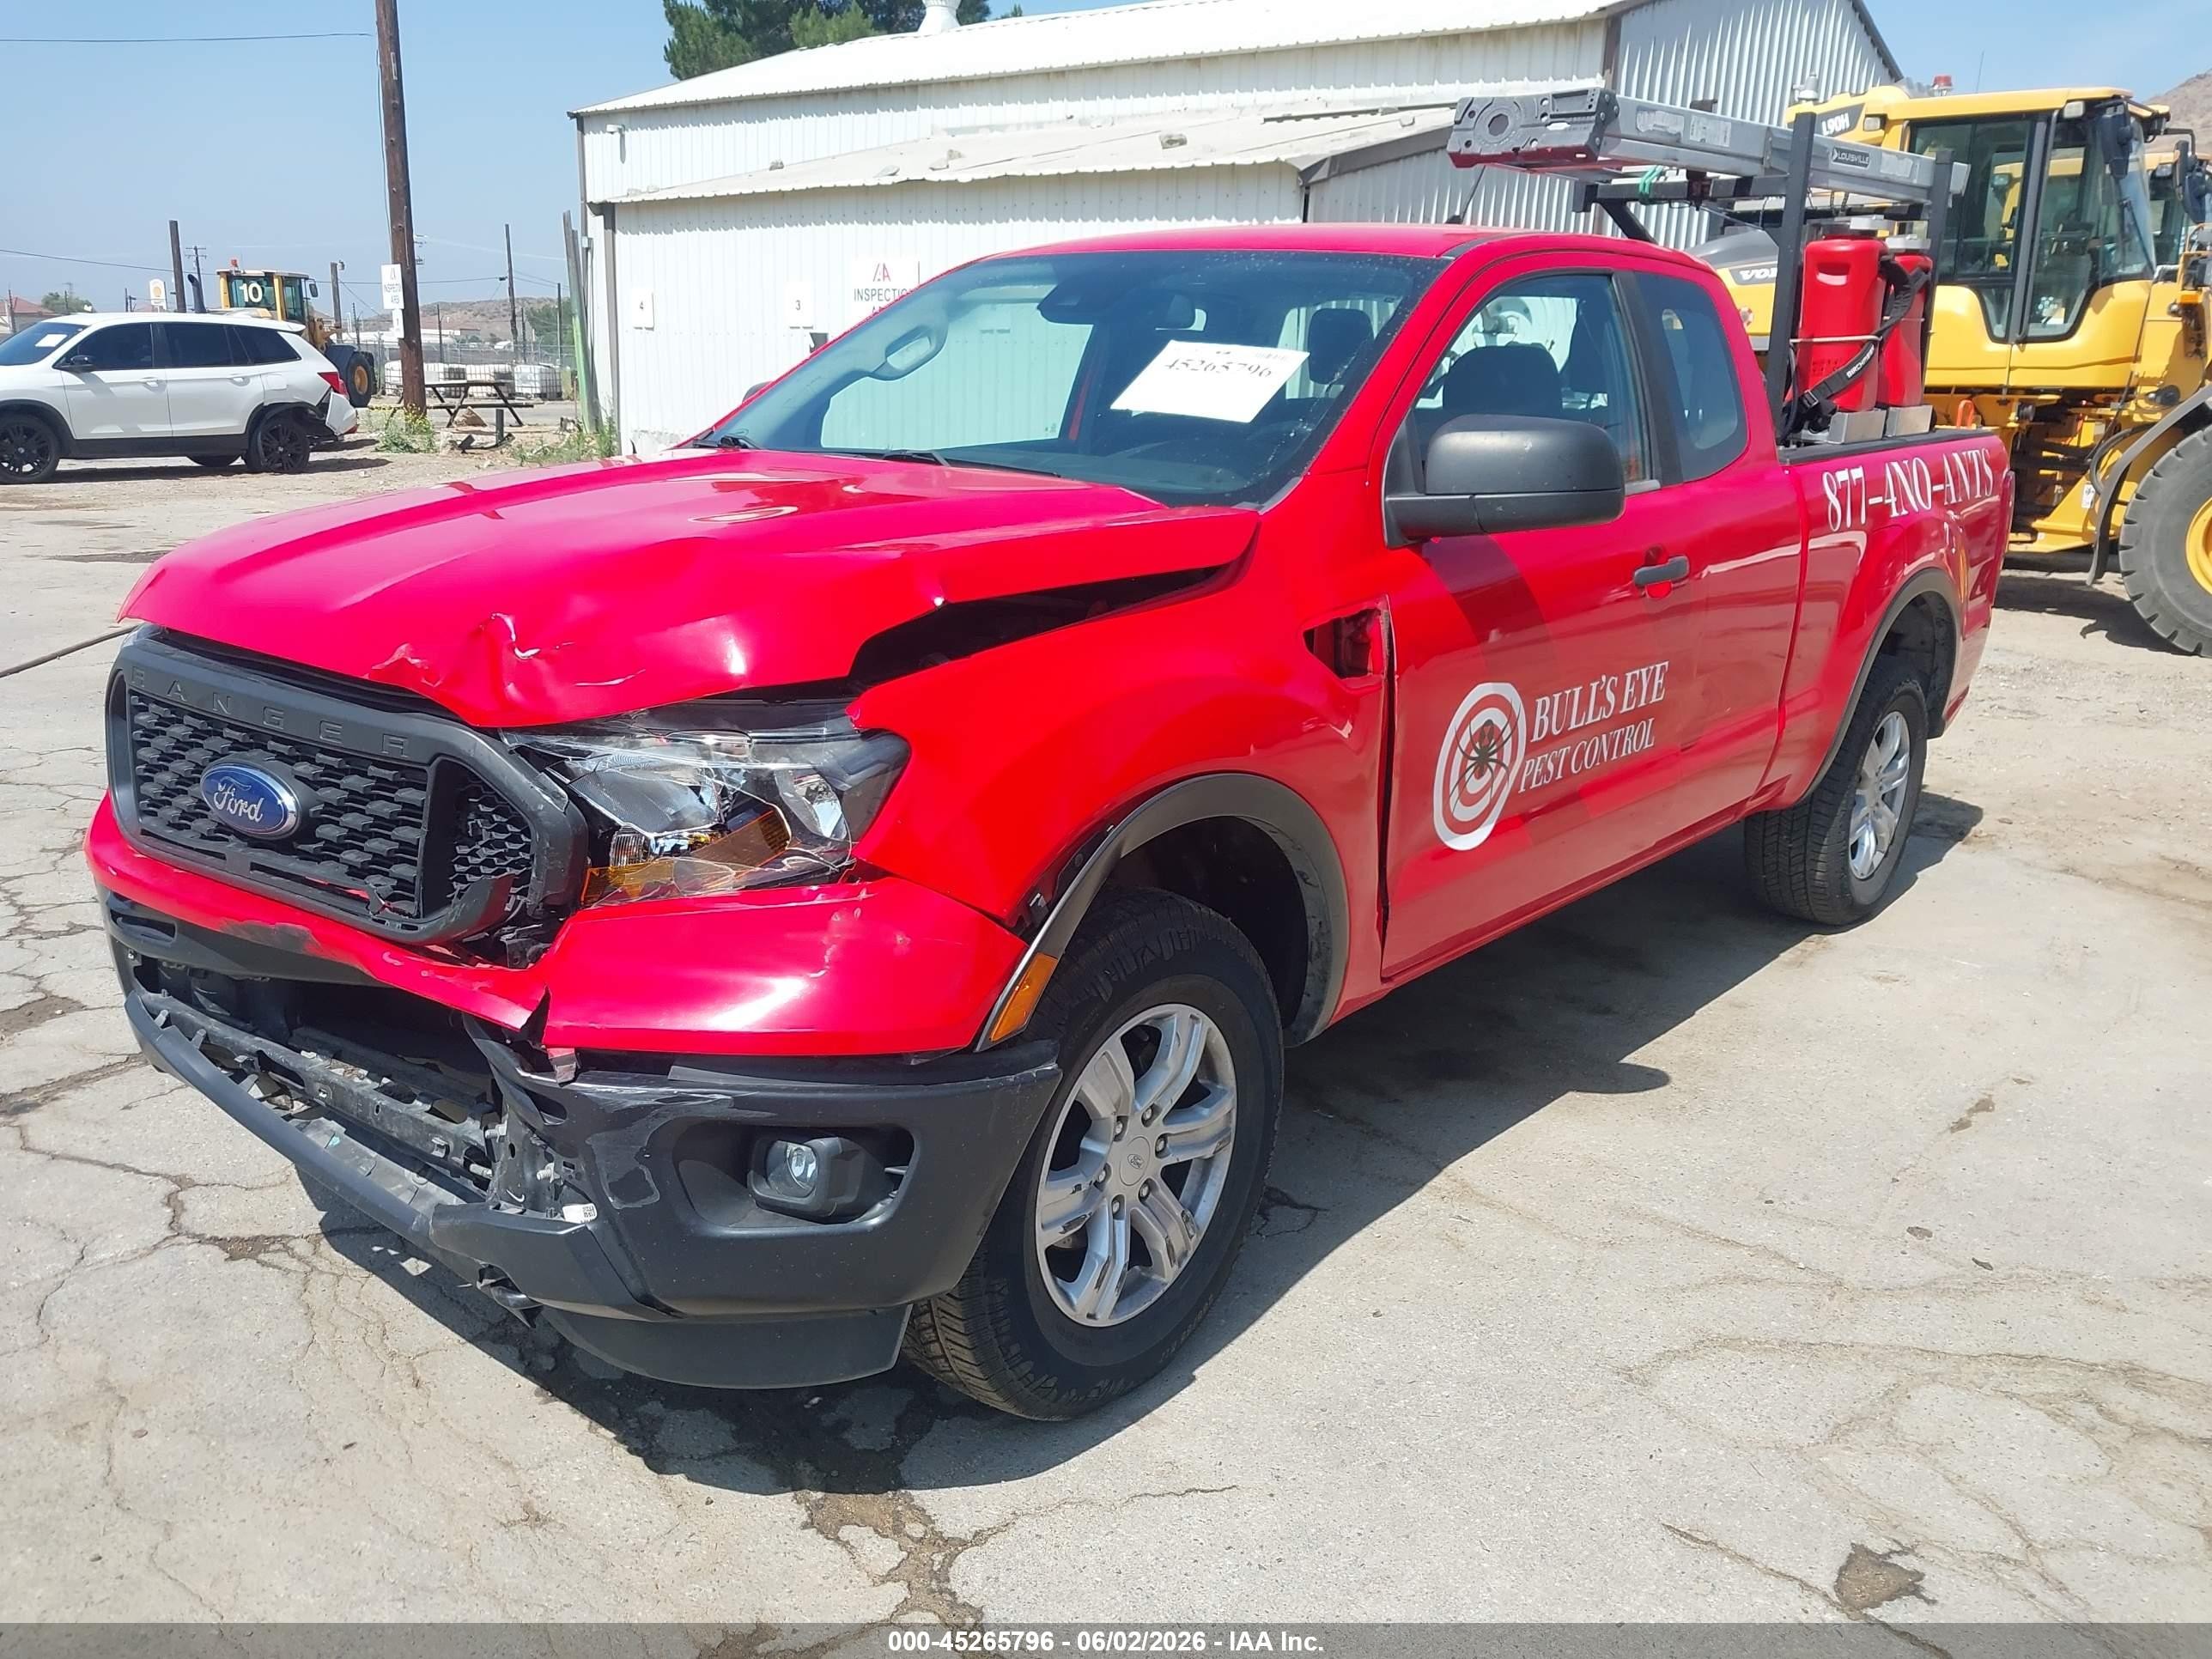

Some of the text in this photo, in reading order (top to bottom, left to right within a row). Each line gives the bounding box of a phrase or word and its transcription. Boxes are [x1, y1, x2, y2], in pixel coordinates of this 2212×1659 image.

[1821, 112, 1850, 137] L90H
[1837, 149, 1870, 165] LOUISVILLE
[1739, 268, 1778, 281] VOL
[239, 283, 263, 303] 10
[1164, 359, 1272, 377] 45265796
[1822, 448, 1993, 532] 877-4NO-ANTS
[131, 665, 409, 758] RANGER
[1530, 661, 1668, 742] BULL'S EYE
[1518, 718, 1655, 793] PEST CONTROL
[213, 776, 264, 823] Ford
